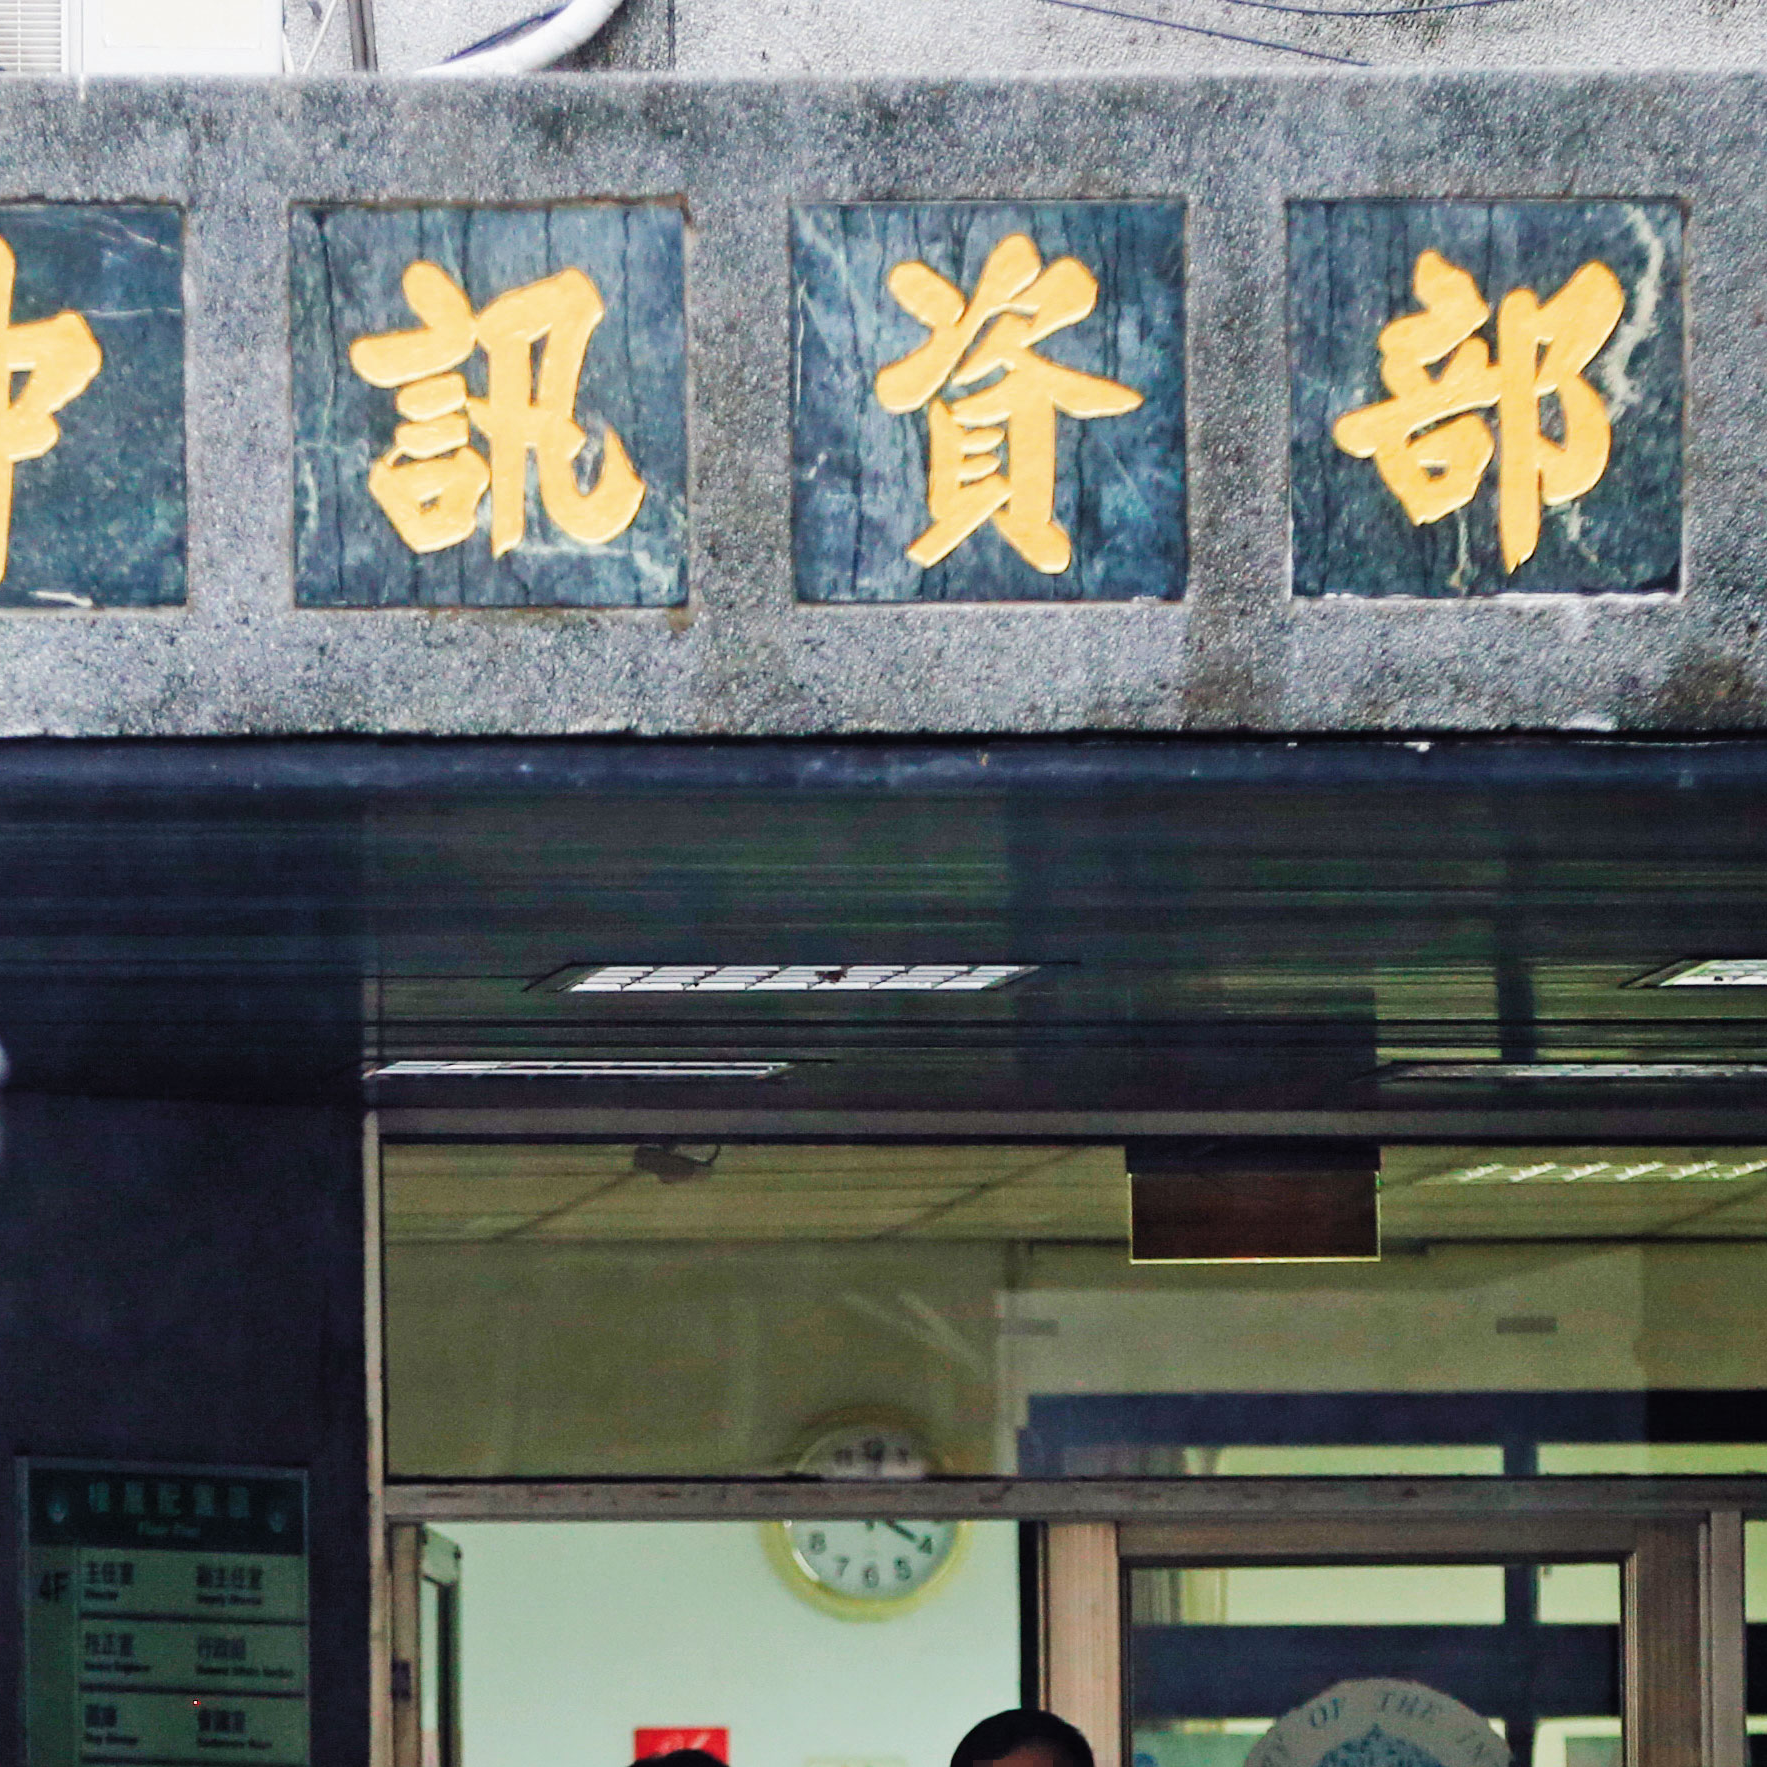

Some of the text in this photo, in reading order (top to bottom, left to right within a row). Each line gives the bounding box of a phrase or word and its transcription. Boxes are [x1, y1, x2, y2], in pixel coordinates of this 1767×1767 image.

[808, 1530, 933, 1556] 8 4
[834, 1554, 914, 1590] 7 6 5
